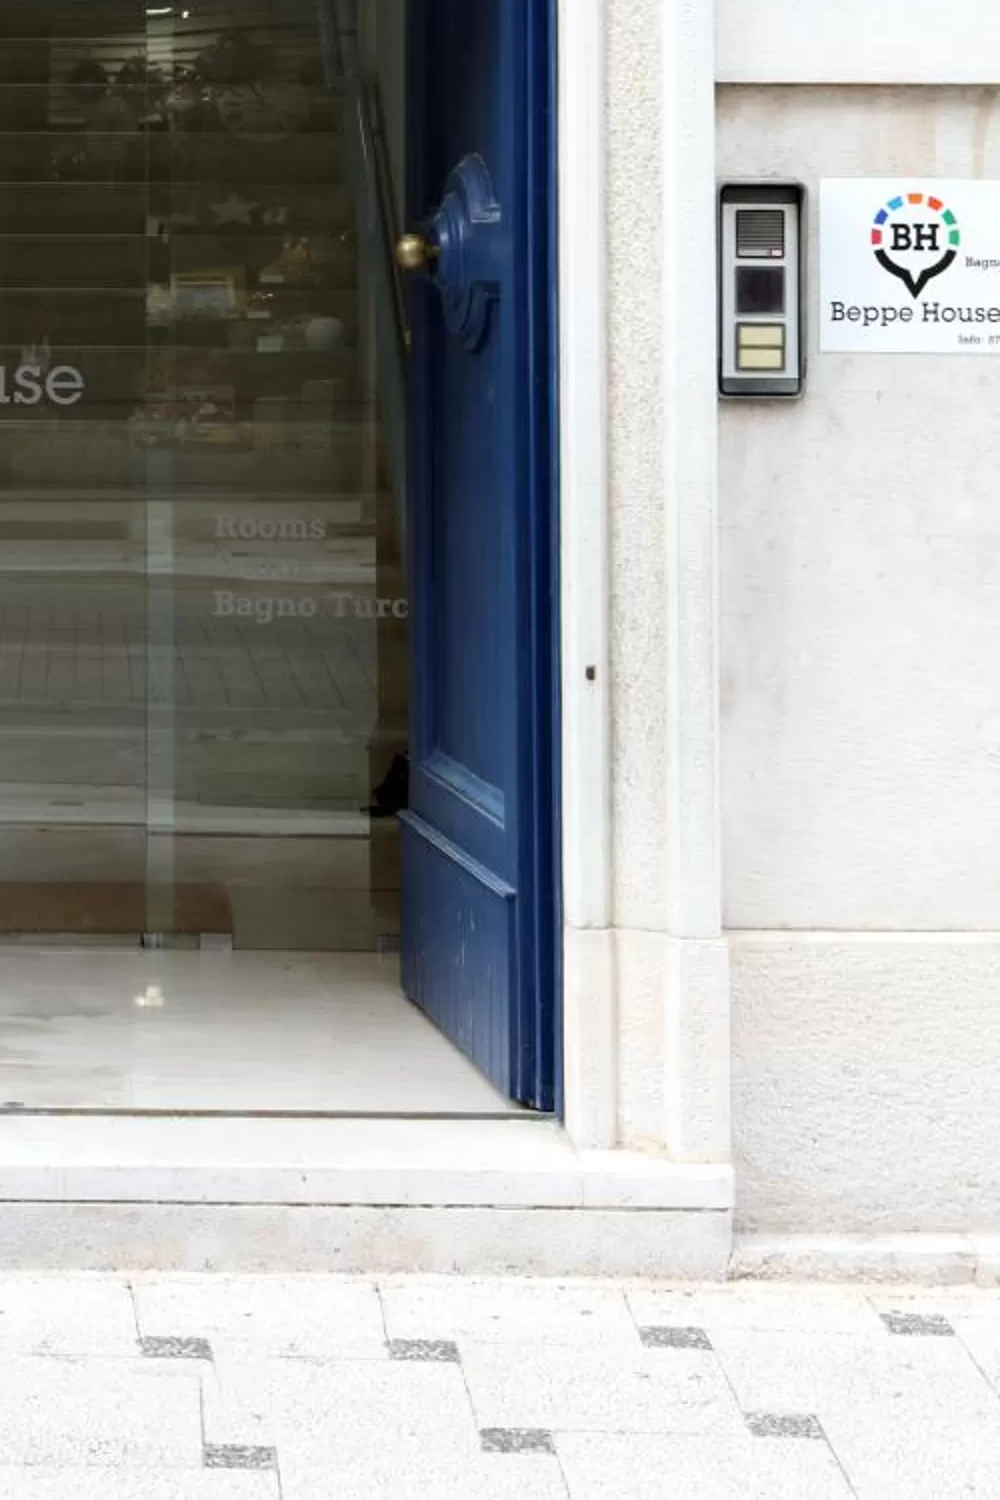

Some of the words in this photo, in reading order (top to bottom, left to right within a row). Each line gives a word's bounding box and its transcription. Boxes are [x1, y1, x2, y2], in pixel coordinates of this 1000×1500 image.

[889, 223, 940, 251] BH
[830, 301, 914, 327] Beppe
[921, 302, 1000, 323] House
[214, 513, 327, 539] Rooms
[212, 590, 317, 625] Bagno
